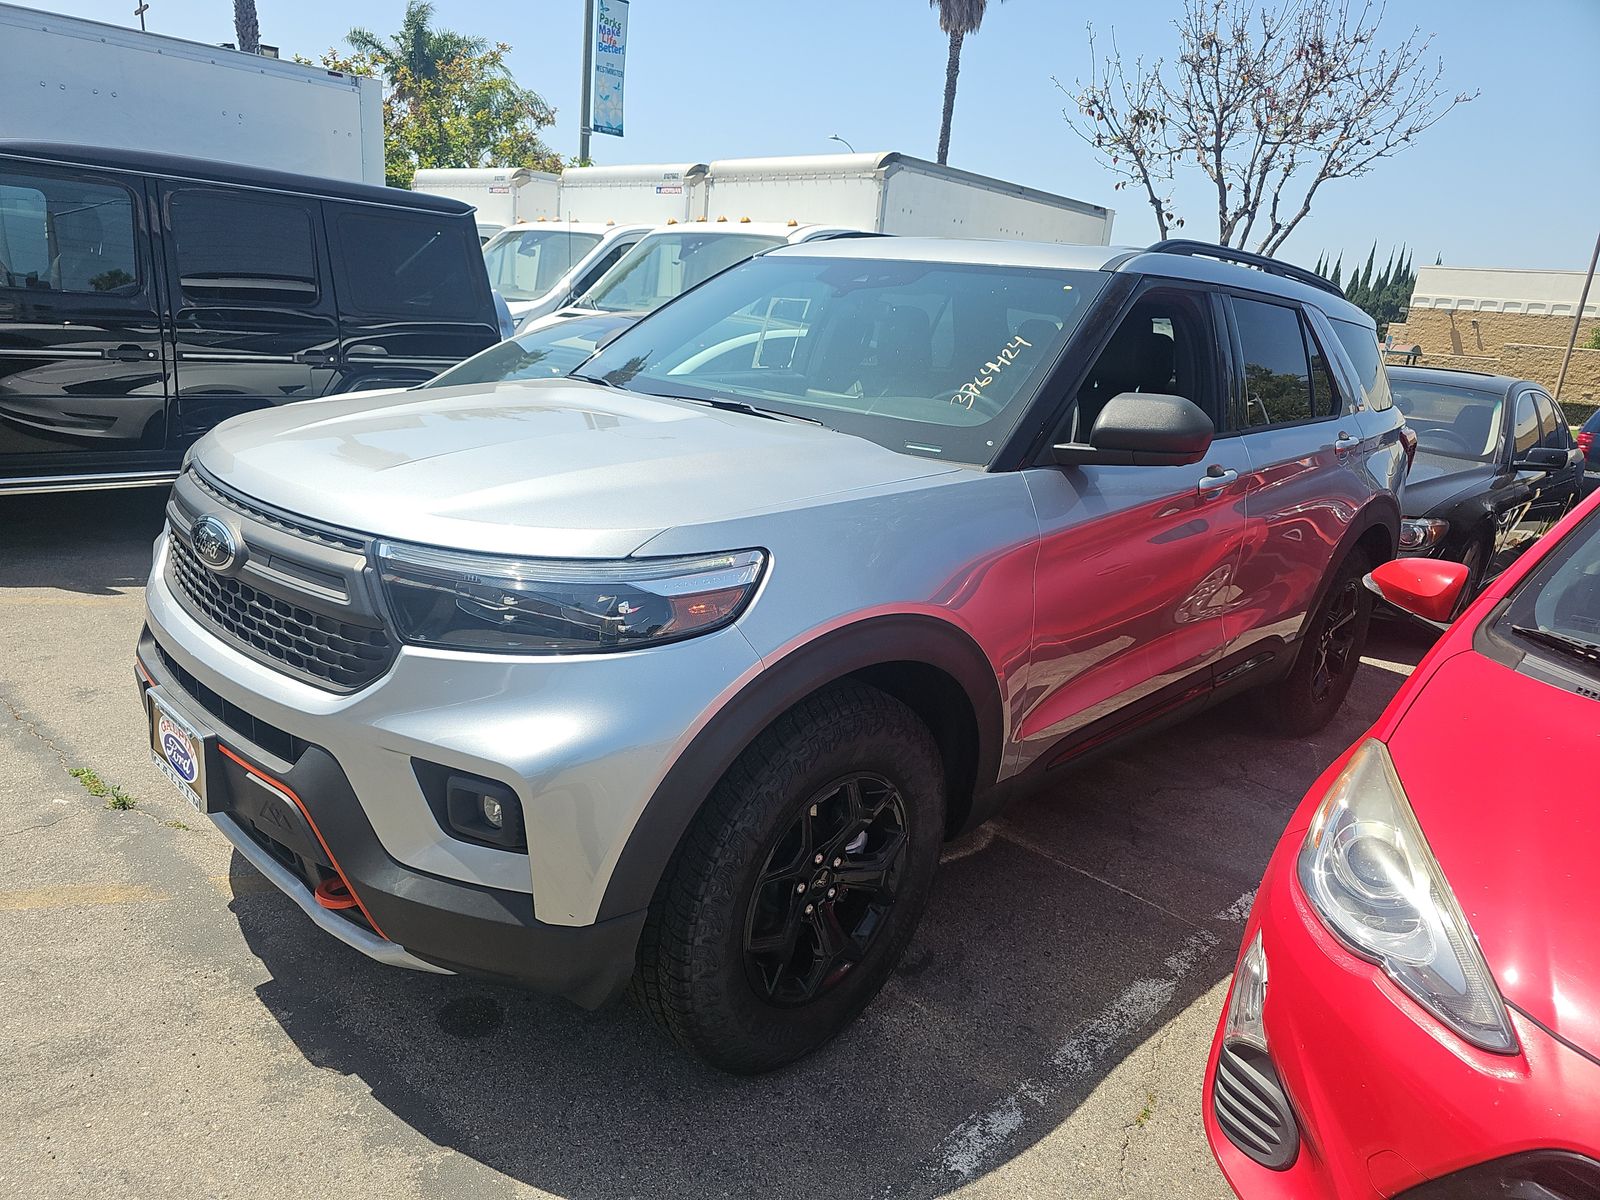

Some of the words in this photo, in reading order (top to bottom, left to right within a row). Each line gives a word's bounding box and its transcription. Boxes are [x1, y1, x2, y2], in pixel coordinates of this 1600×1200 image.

[600, 13, 621, 30] Parks
[599, 25, 620, 37] Make
[602, 34, 616, 45] Life
[195, 525, 221, 560] Ford
[166, 736, 191, 775] Ford
